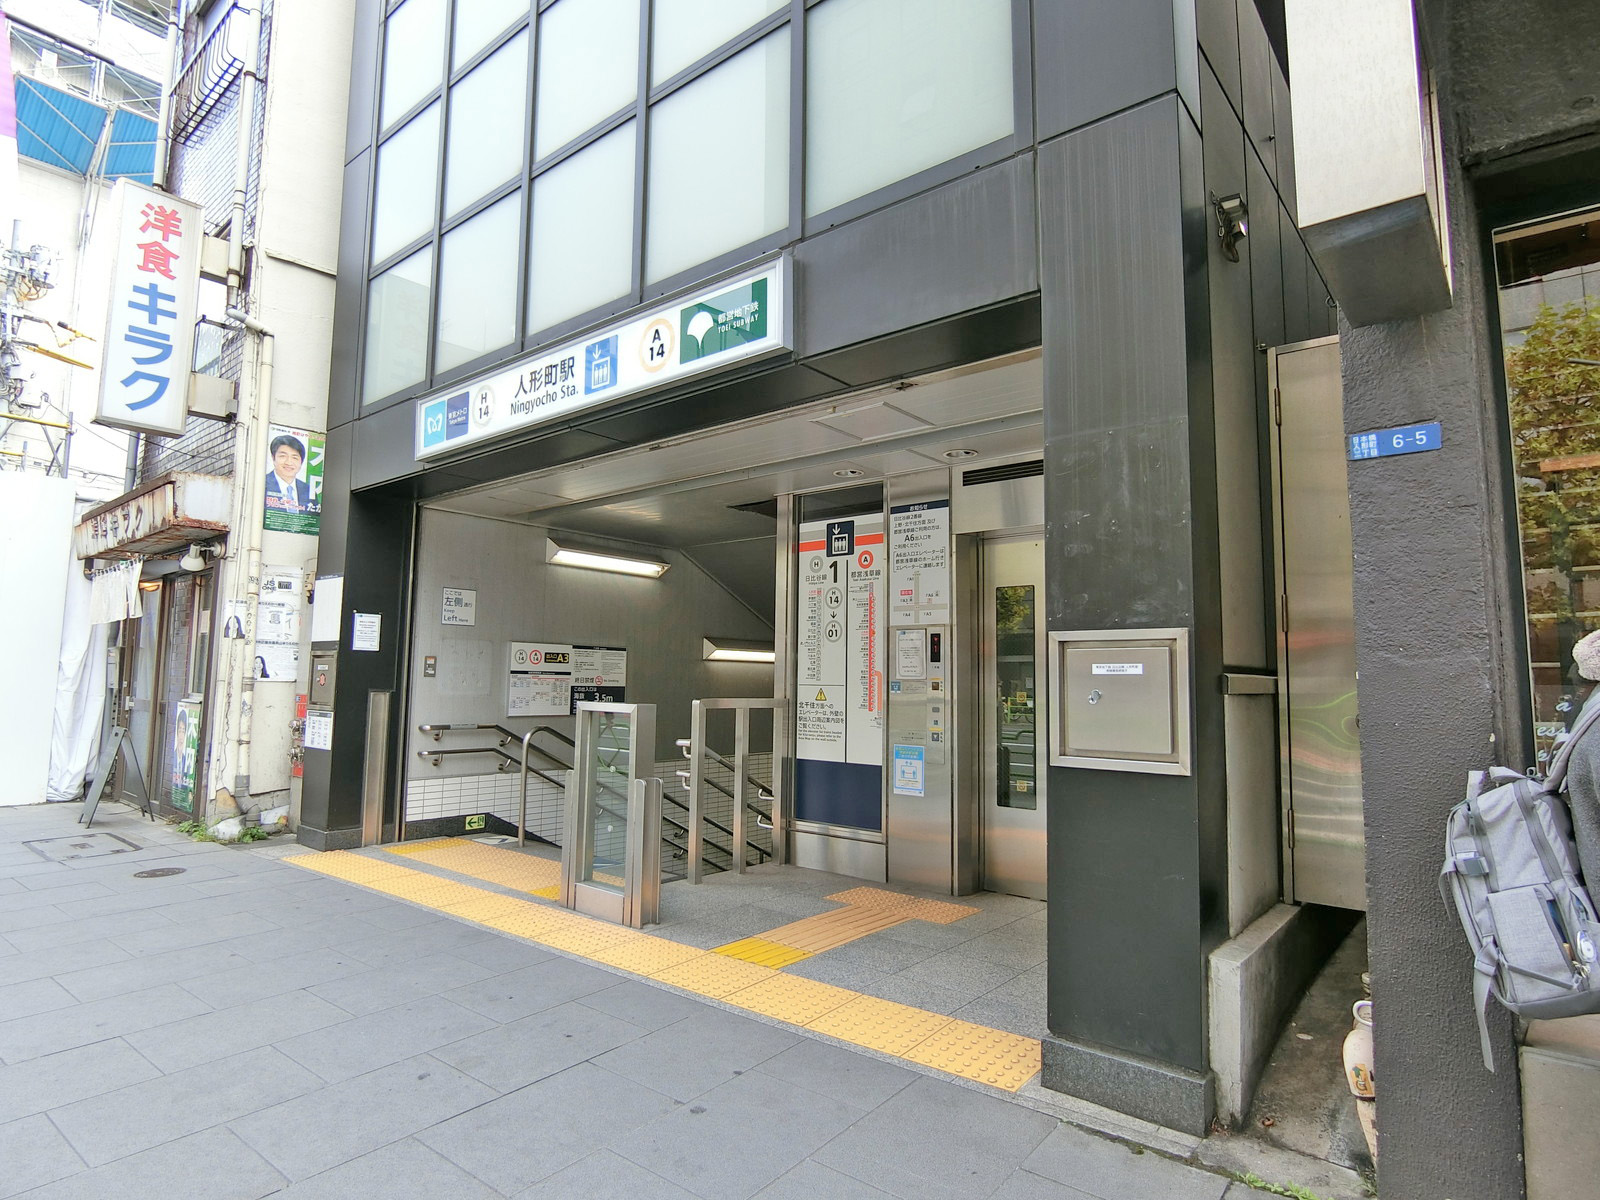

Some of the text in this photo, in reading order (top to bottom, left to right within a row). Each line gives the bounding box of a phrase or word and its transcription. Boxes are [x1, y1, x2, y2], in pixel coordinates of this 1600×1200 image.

[120, 202, 183, 412] 洋食キラク
[718, 301, 759, 324] 都営地下鉄
[718, 314, 759, 334] TOEI SUBWAY
[652, 328, 661, 344] A
[649, 344, 666, 361] 14
[514, 356, 574, 398] 人形町駅
[480, 392, 488, 404] H
[510, 384, 578, 416] Ningyocho Sta.
[448, 407, 468, 420] 東京メトロ
[478, 405, 490, 419] 14
[1392, 430, 1427, 448] 6-5
[829, 561, 838, 583] 1
[851, 570, 881, 578] 都営浅草線
[829, 596, 839, 604] 14
[557, 654, 569, 662] A3
[594, 692, 613, 702] 3.5m
[799, 716, 844, 724] 駅出入口周辺案内図を
